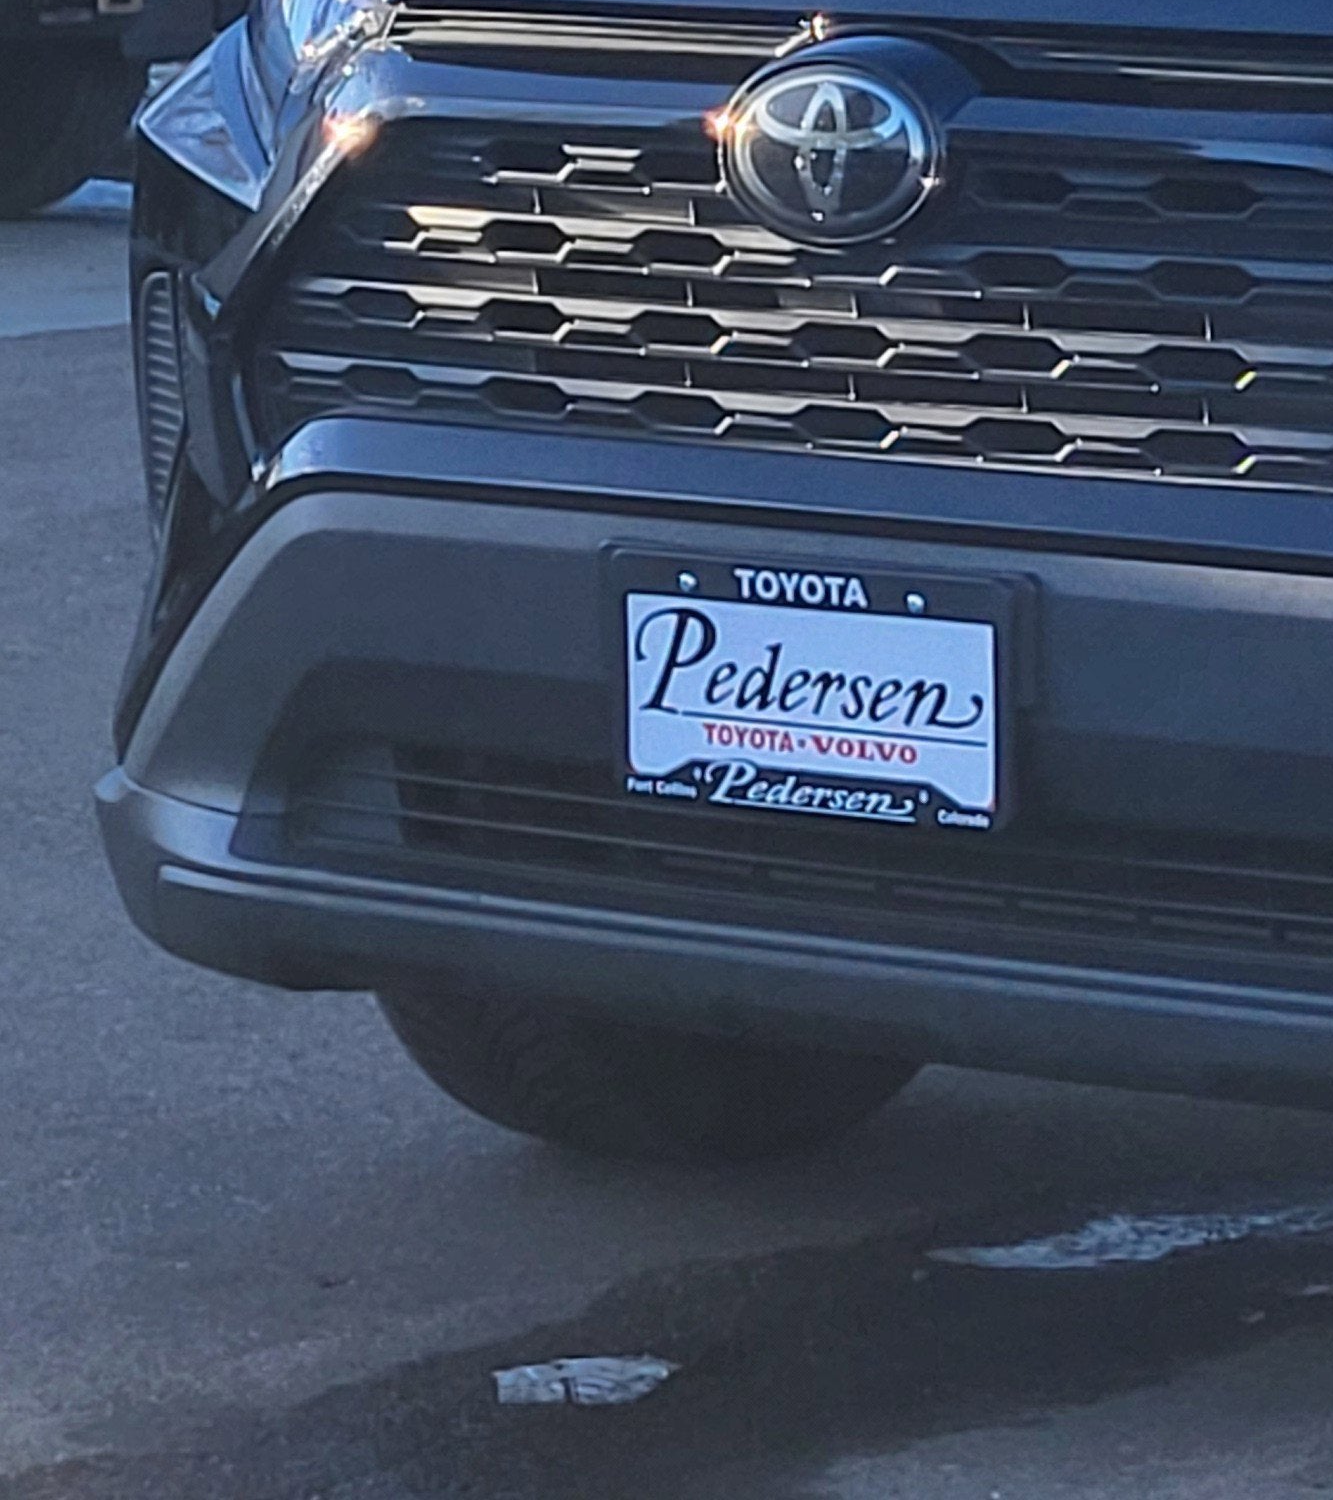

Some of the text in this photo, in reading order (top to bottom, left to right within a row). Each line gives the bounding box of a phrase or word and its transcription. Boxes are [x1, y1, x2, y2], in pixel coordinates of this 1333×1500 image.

[734, 568, 868, 608] TOYOTA
[634, 608, 984, 728] Pedersen
[704, 760, 914, 814] Pedersen
